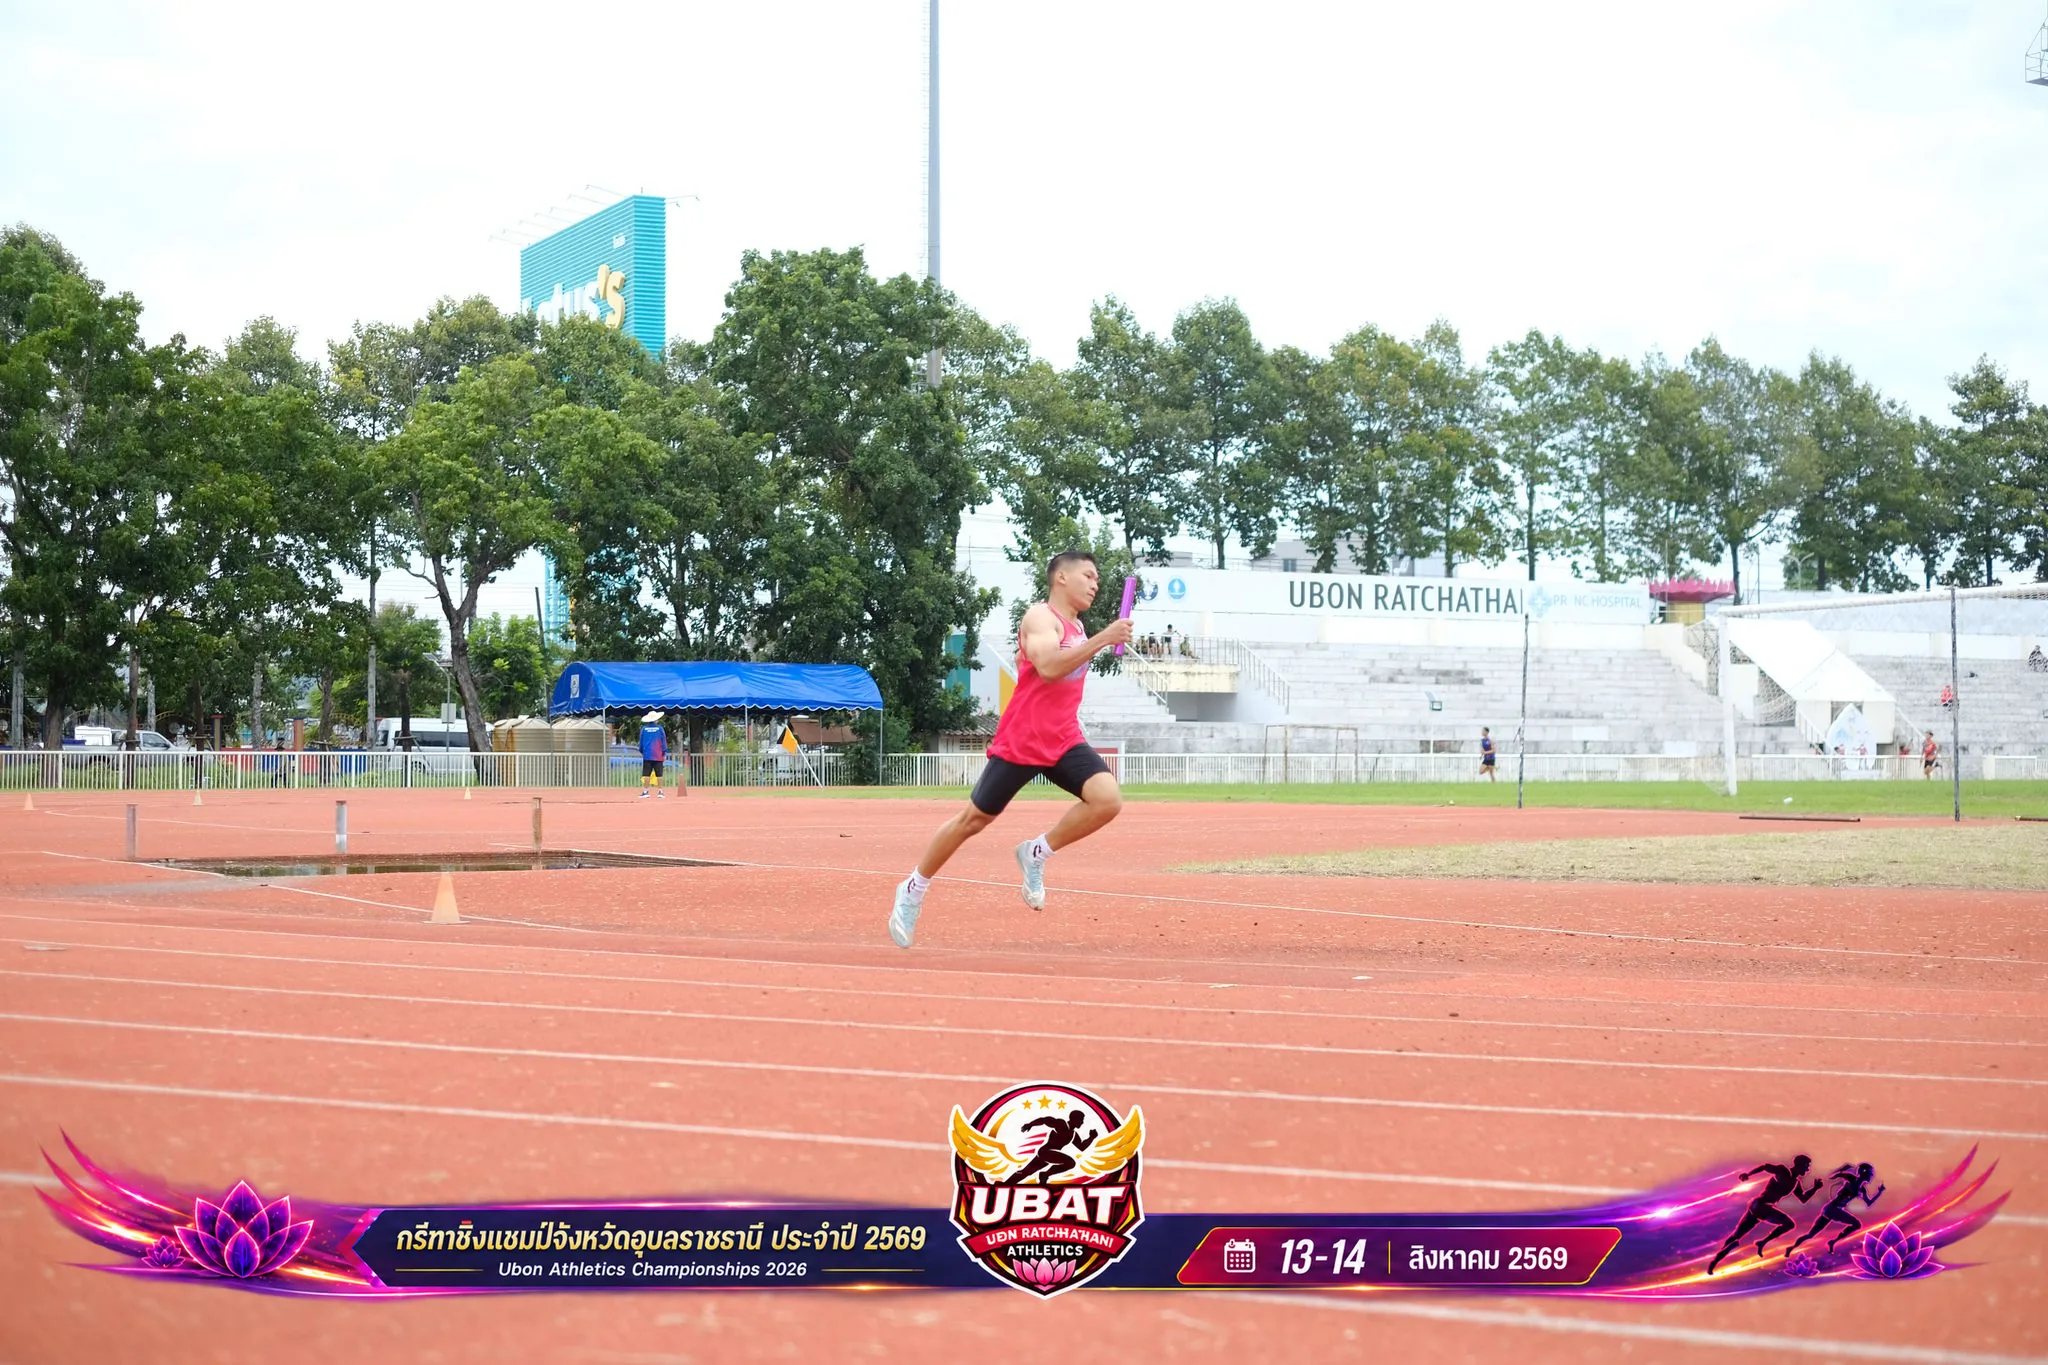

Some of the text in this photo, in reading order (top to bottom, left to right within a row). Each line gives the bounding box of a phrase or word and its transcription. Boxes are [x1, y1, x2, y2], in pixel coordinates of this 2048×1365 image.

[1289, 581, 1523, 614] UBON RATCHATHA
[1591, 595, 1642, 608] HOSPITAL
